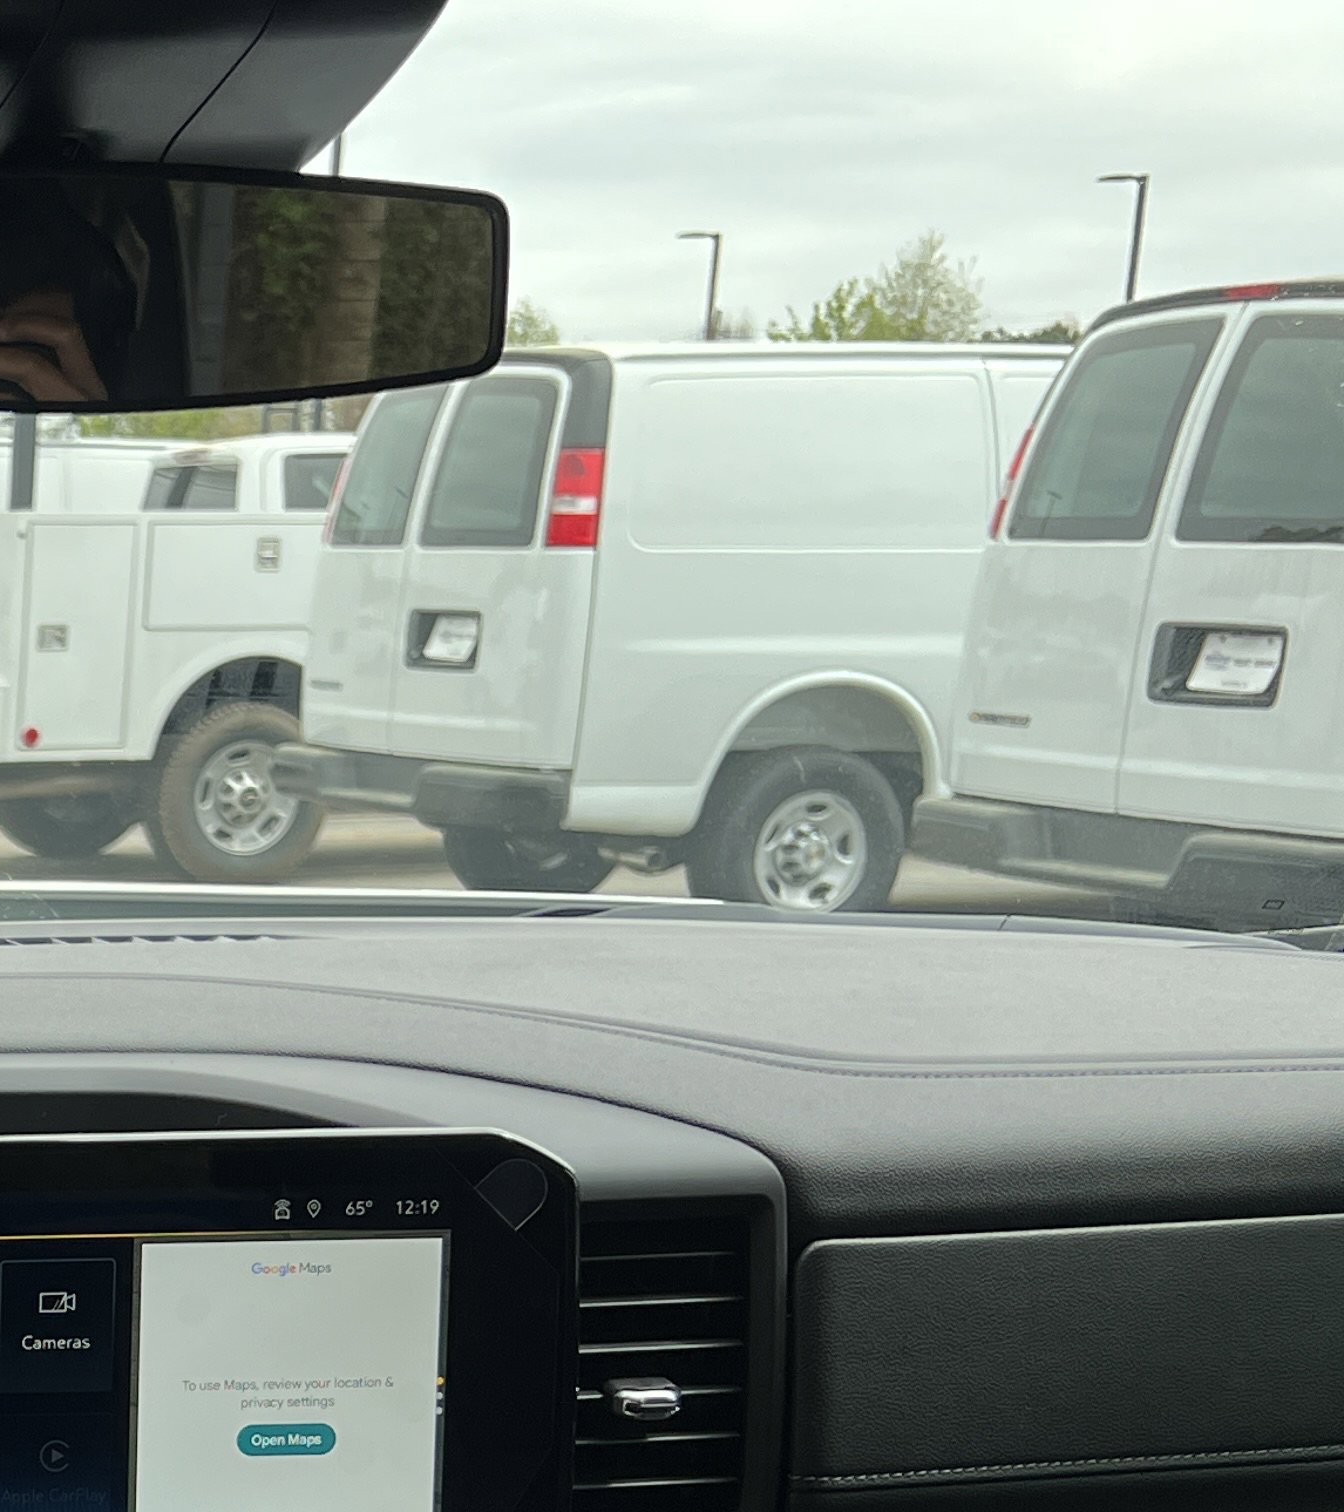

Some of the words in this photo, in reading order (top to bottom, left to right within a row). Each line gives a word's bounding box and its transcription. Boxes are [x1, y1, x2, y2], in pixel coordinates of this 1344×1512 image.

[345, 1200, 373, 1216] 65°
[396, 1199, 440, 1215] 12:19
[251, 1262, 297, 1277] Google
[299, 1262, 332, 1276] Maps
[22, 1335, 91, 1351] Cameras
[183, 1380, 196, 1392] To
[199, 1381, 220, 1391] use
[263, 1379, 302, 1391] review
[305, 1379, 331, 1391] your
[334, 1377, 381, 1389] location
[385, 1377, 394, 1387] &
[241, 1396, 283, 1410] privacy
[287, 1395, 335, 1409] settings
[251, 1434, 286, 1448] Open
[288, 1434, 322, 1447] Maps
